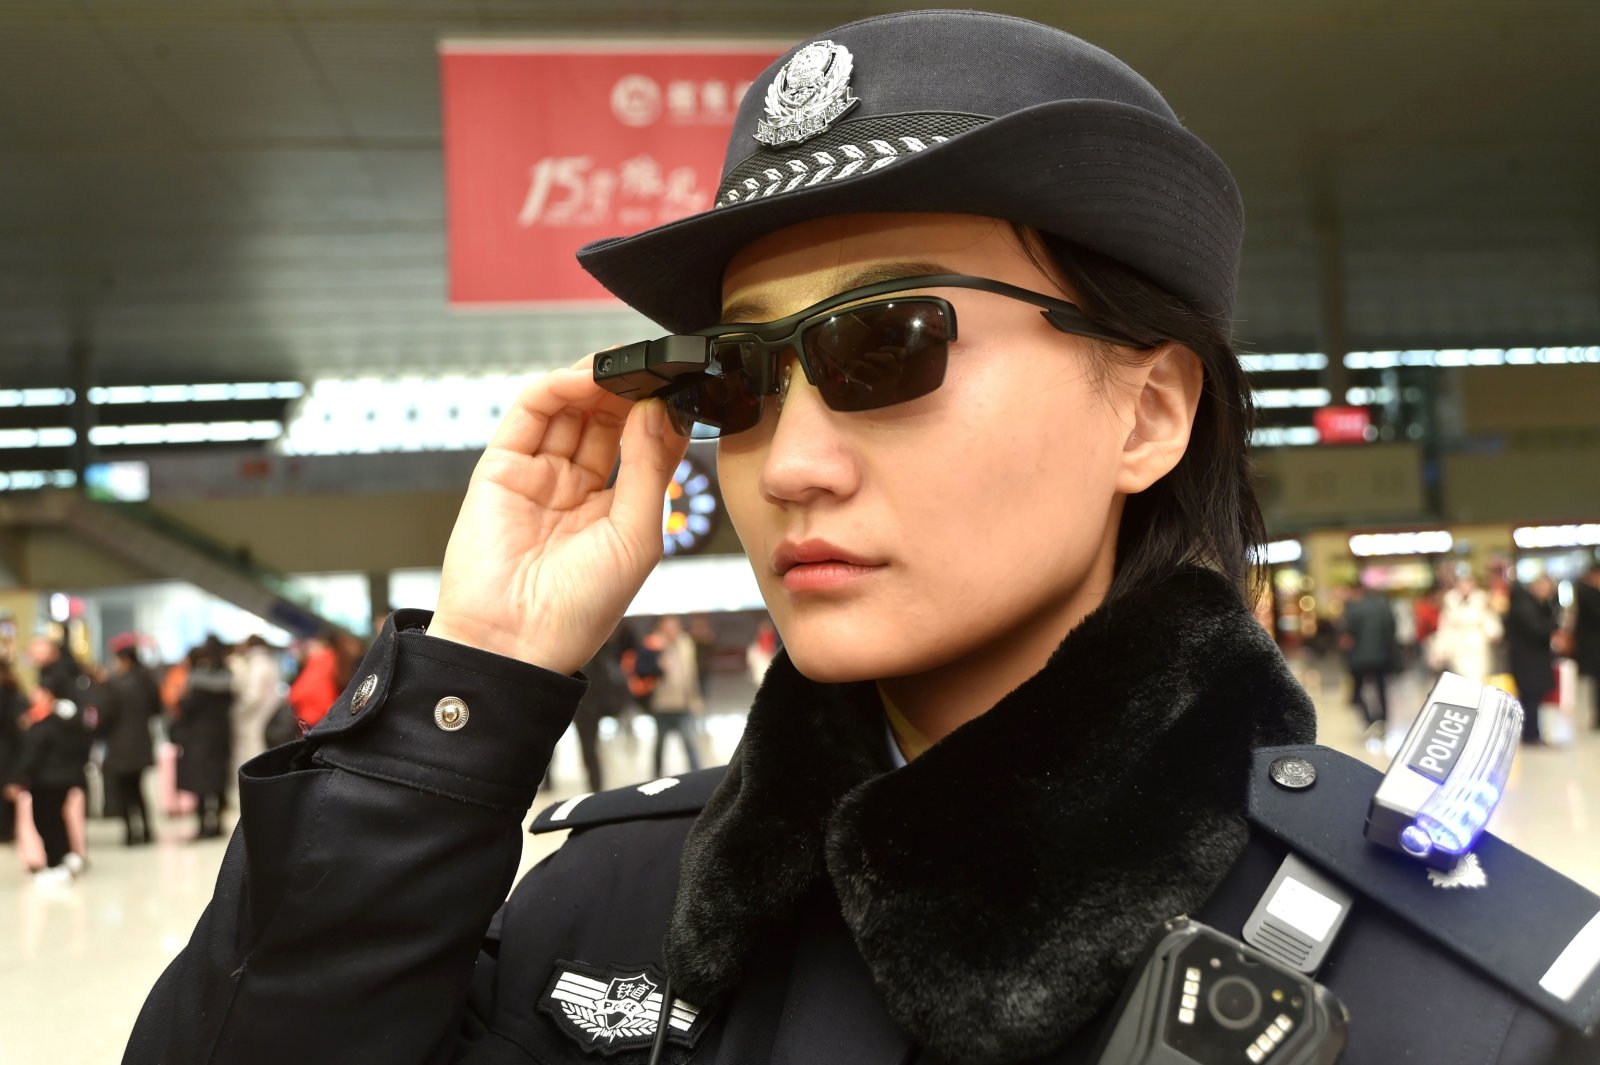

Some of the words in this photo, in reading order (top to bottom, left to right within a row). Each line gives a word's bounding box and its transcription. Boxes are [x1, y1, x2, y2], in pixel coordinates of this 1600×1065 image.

[1418, 708, 1469, 774] POLICE
[616, 982, 650, 1000] 铁道
[603, 1001, 637, 1012] POCE
